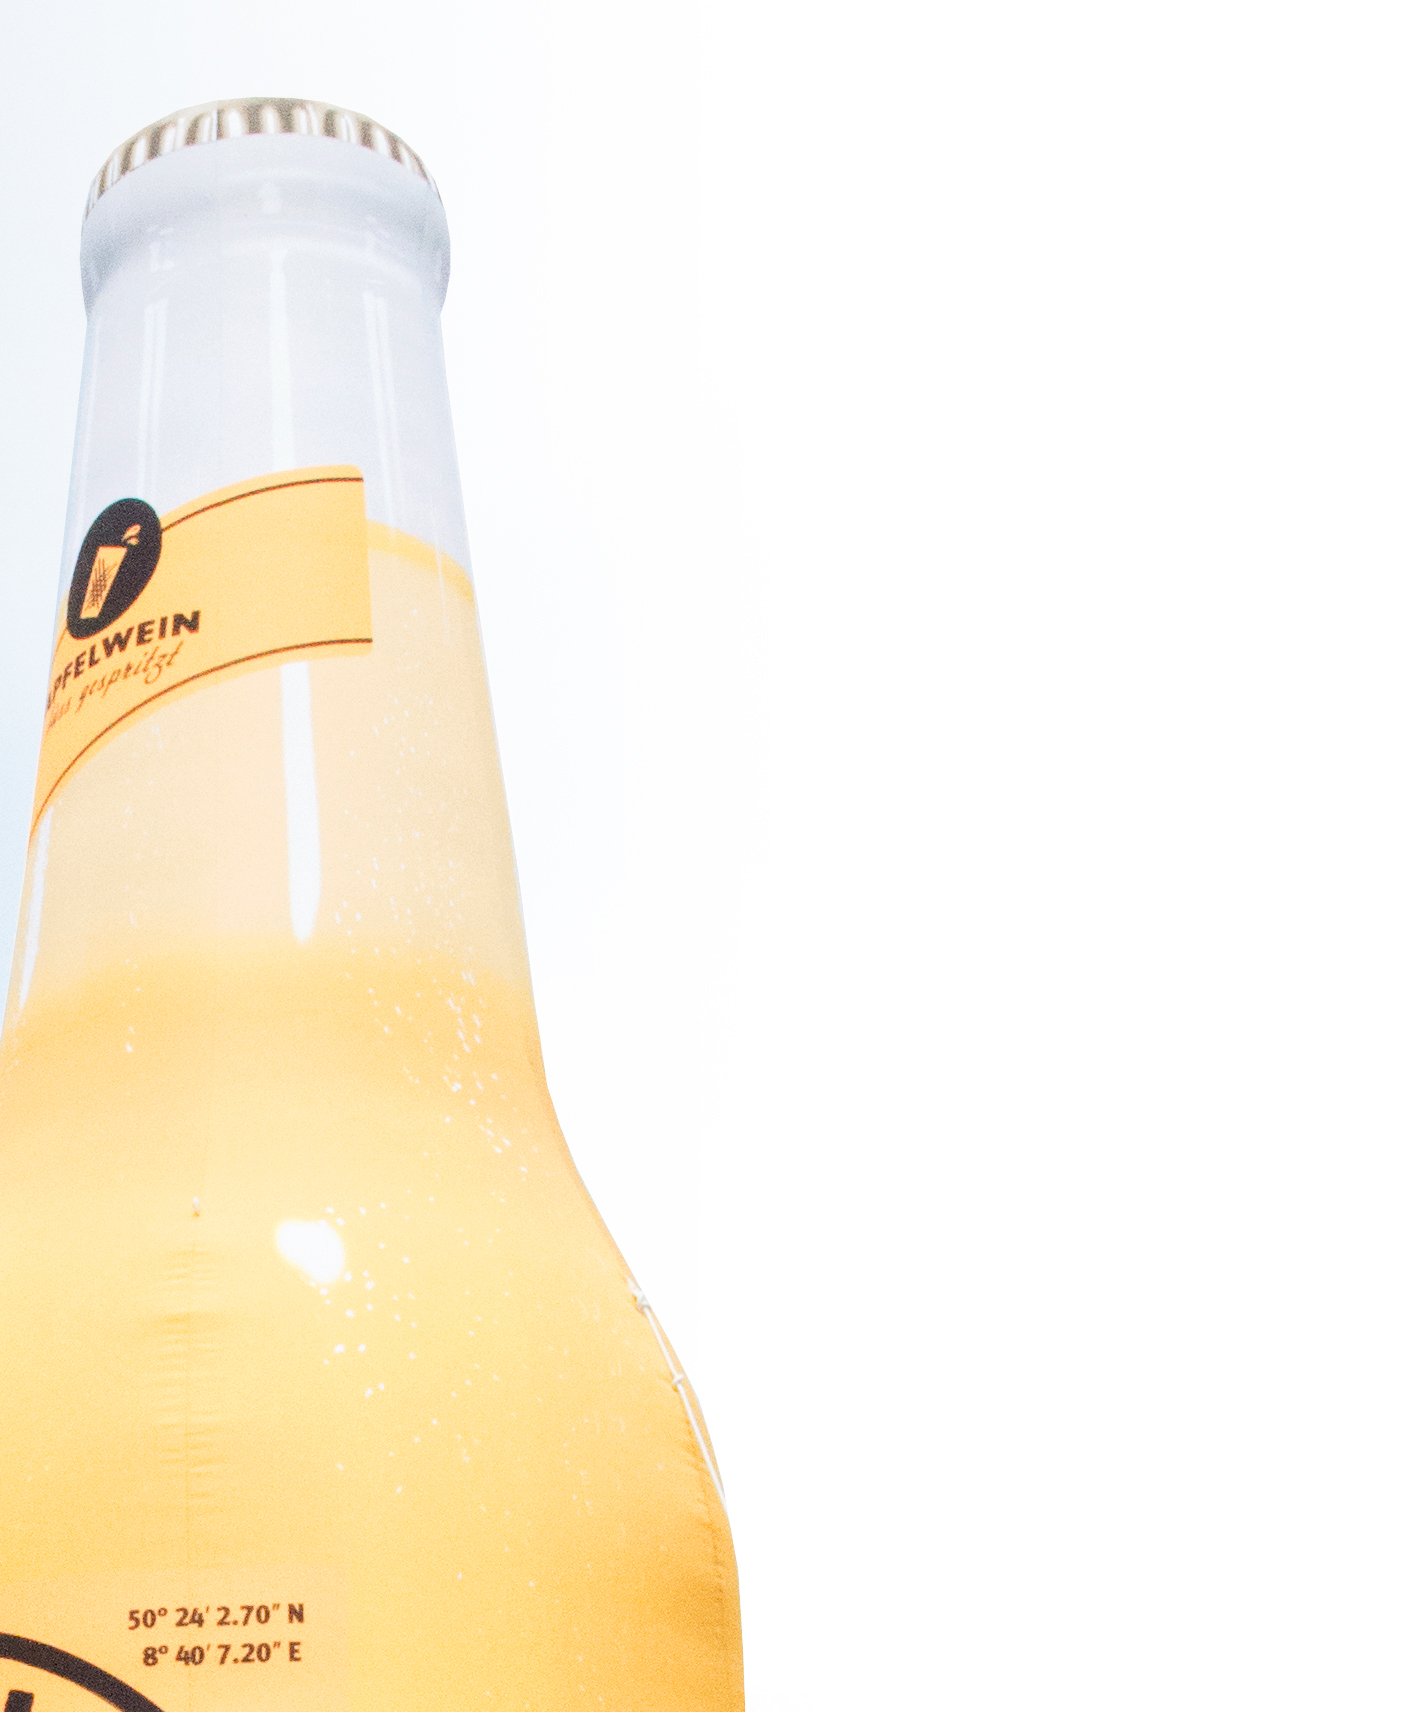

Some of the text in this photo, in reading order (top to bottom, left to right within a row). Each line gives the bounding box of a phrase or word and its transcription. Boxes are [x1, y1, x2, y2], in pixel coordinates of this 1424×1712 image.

[46, 609, 201, 709] PFELWEIN
[288, 1602, 304, 1624] N
[289, 1641, 302, 1662] E
